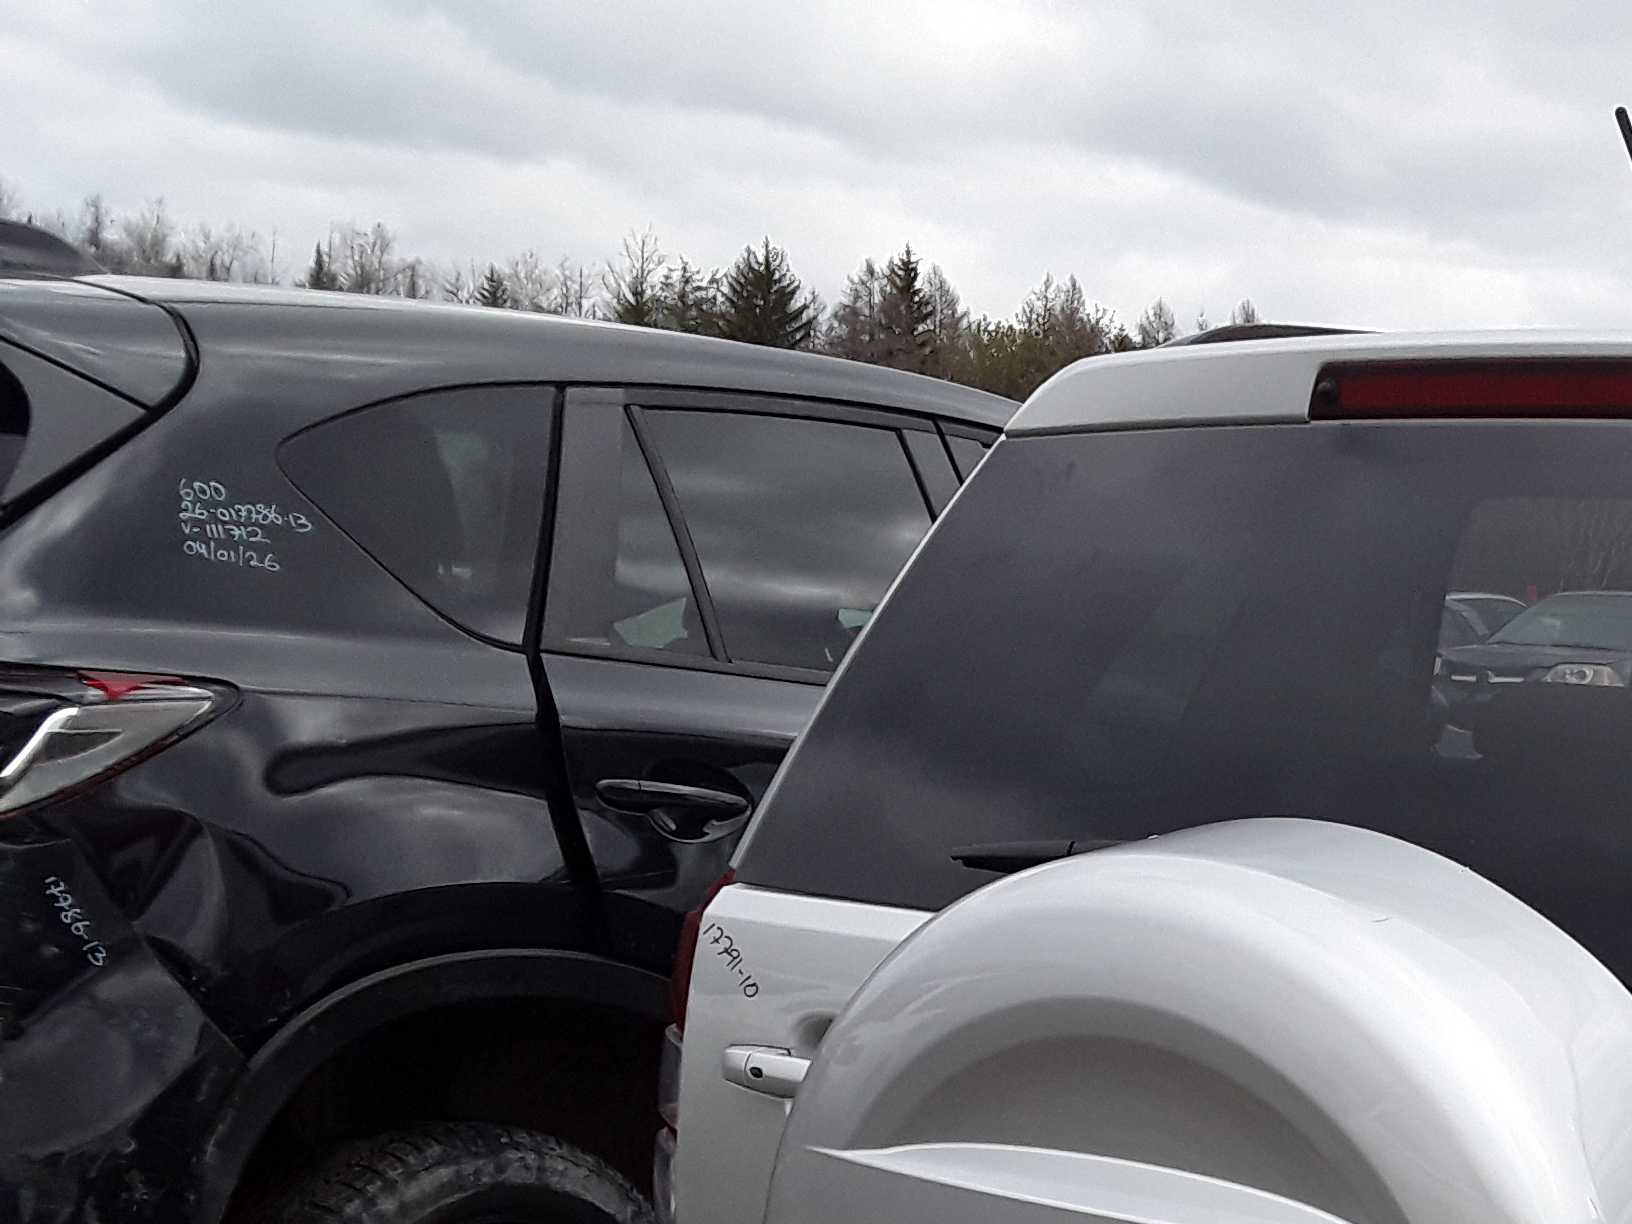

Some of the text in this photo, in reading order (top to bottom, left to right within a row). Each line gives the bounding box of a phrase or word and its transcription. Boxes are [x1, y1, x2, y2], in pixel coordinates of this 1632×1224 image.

[179, 479, 226, 501] 600
[183, 541, 280, 571] 04/01/26
[703, 923, 759, 998] 17791-10
